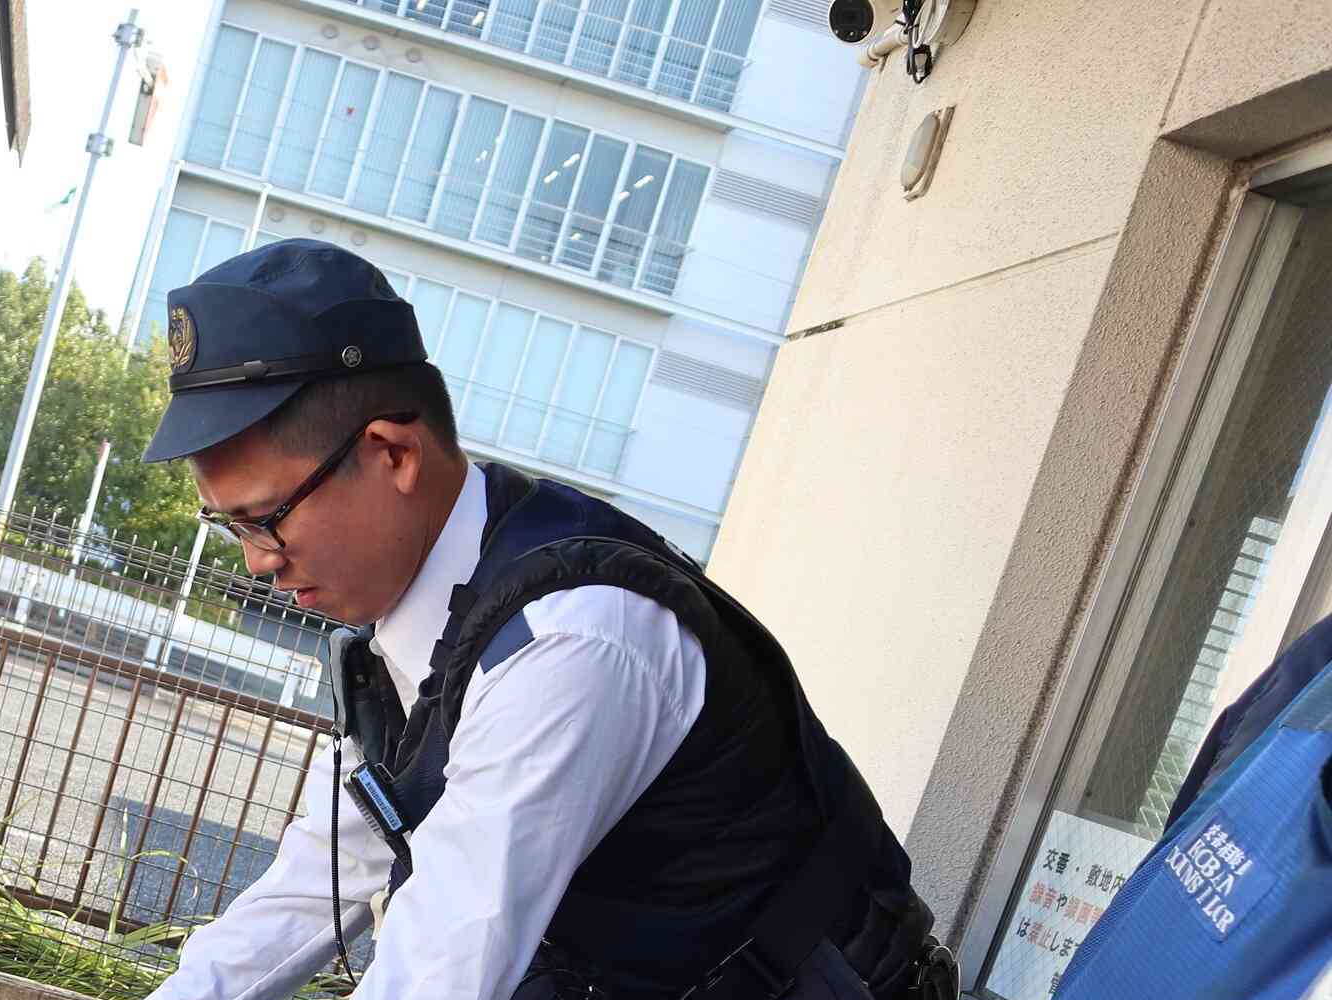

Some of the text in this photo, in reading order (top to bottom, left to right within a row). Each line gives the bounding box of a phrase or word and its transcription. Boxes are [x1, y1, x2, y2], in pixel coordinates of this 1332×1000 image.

[1016, 916, 1082, 958] は禁止しま
